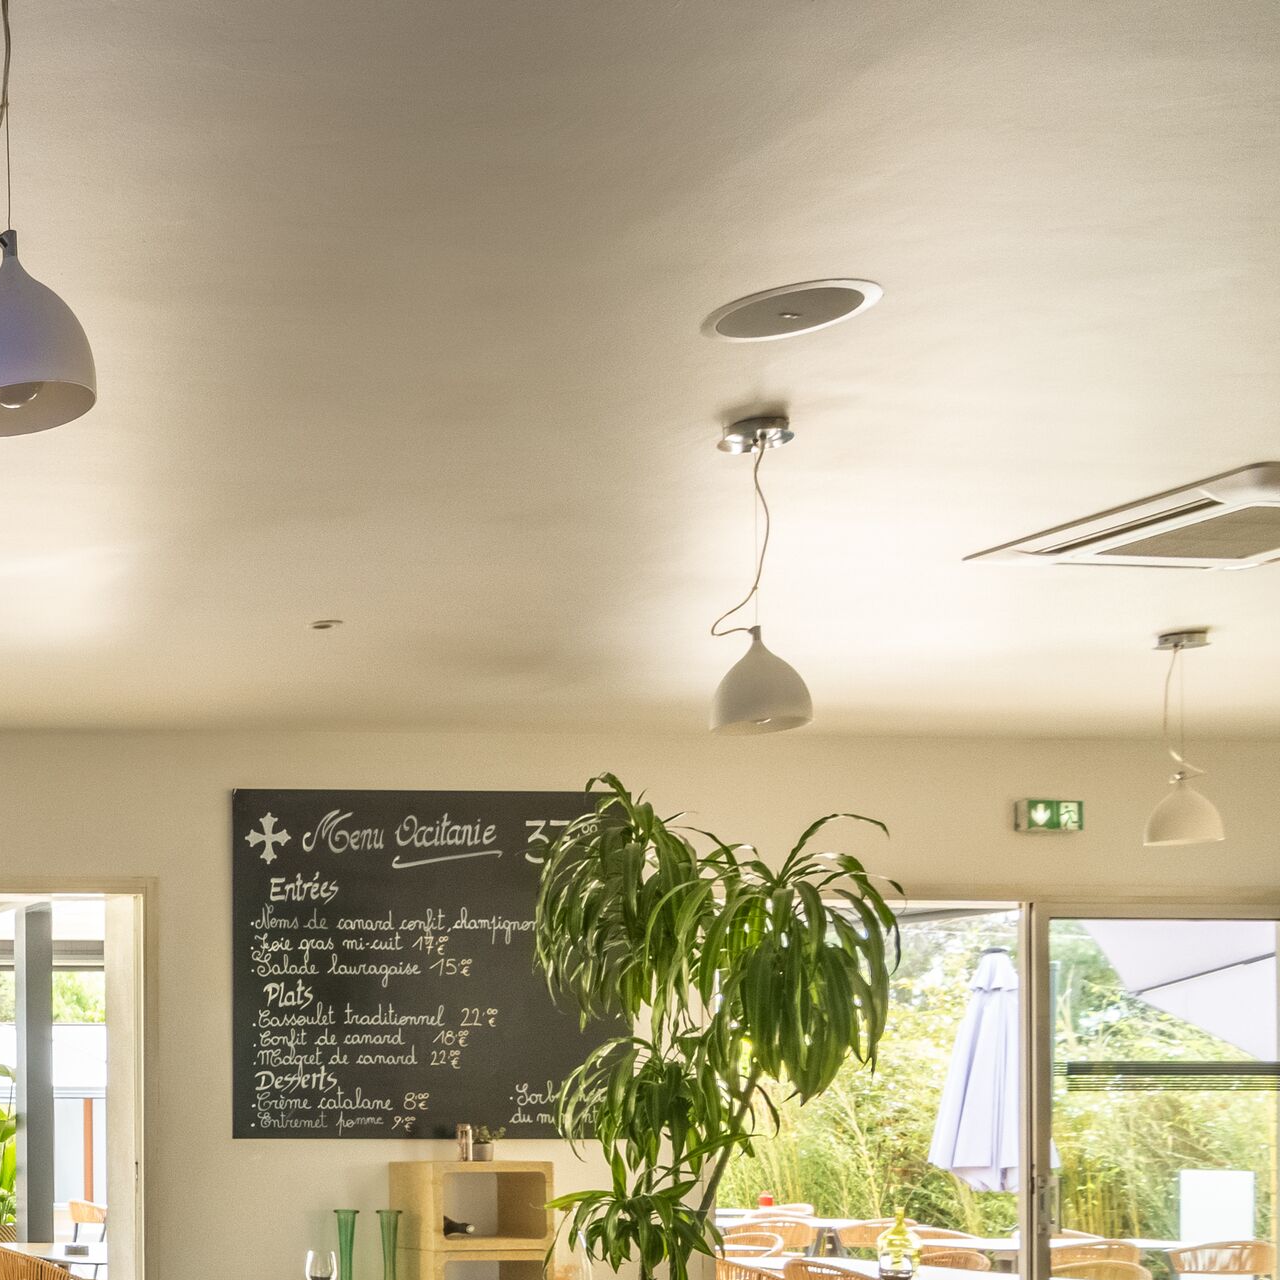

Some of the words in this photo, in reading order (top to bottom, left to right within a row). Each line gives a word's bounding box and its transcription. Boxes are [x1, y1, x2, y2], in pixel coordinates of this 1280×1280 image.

[302, 809, 384, 854] Menu
[395, 813, 497, 848] Occitanie
[269, 871, 339, 905] Entrées
[255, 903, 299, 930] Nems
[303, 907, 329, 930] de
[336, 910, 395, 931] canard
[252, 932, 293, 960] Foie
[298, 937, 334, 963] gras
[342, 932, 403, 951] mi-cuit
[257, 953, 320, 977] Salade
[327, 953, 421, 988] lauragaise
[263, 979, 314, 1010] Plats
[258, 1001, 336, 1028] Cassoulet
[344, 1002, 446, 1027] traditionnel
[259, 1028, 307, 1057] Confit
[314, 1027, 338, 1045] de
[343, 1027, 406, 1045] canard
[257, 1047, 323, 1079] Magret
[328, 1046, 350, 1065] de
[356, 1044, 418, 1065] canard
[254, 1065, 338, 1094] Desserts
[256, 1092, 312, 1111] Crème
[317, 1086, 394, 1111] catalane
[257, 1111, 328, 1129] Entremet
[335, 1110, 385, 1136] pomme
[509, 1106, 533, 1124] du
